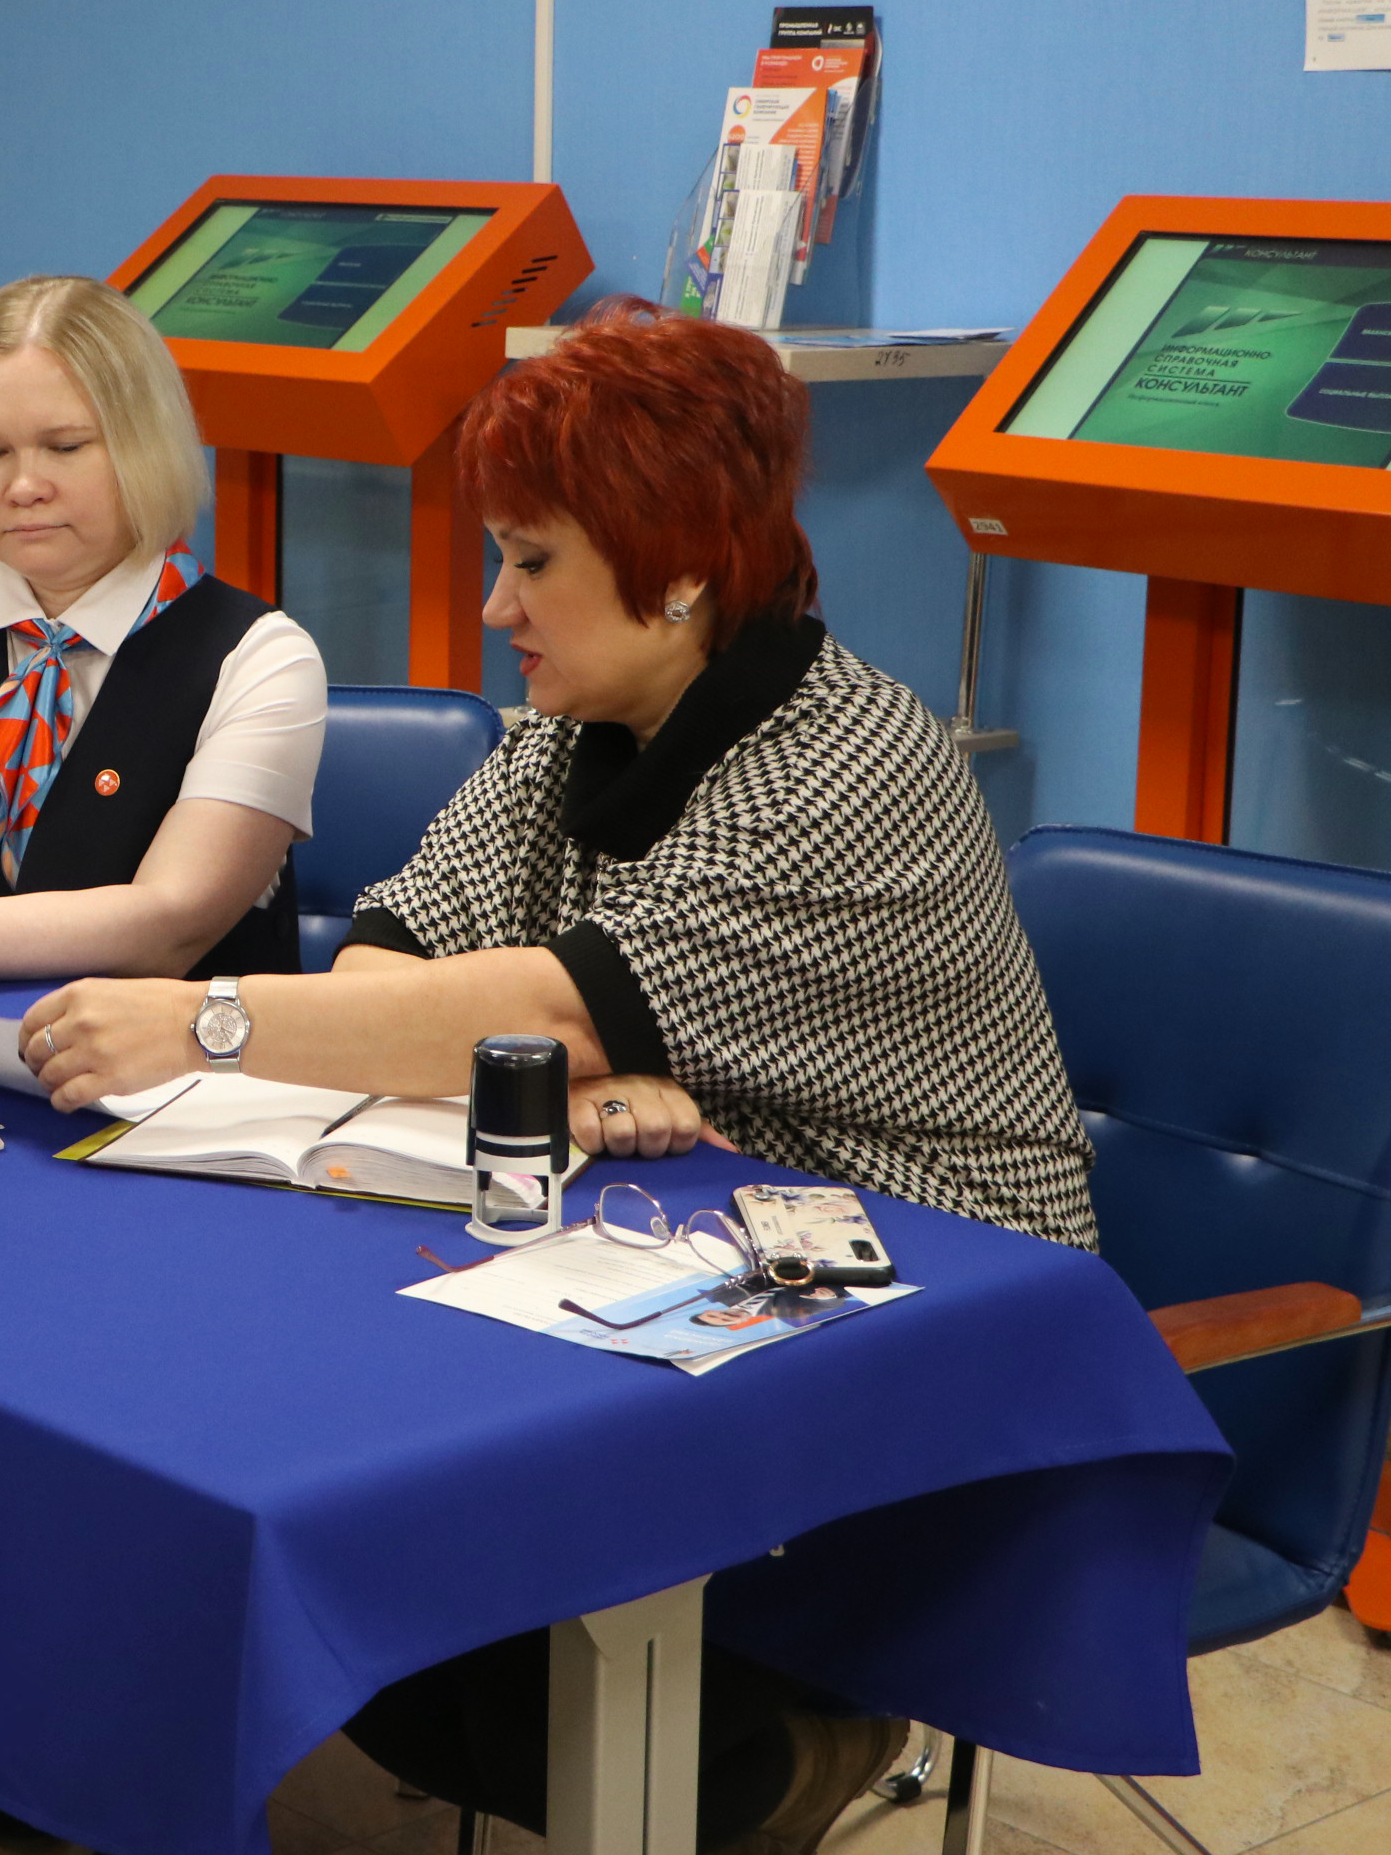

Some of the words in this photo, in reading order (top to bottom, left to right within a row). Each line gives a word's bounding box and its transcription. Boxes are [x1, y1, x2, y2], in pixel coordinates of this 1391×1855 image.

[1155, 354, 1239, 368] СПРАВОЧНАЯ
[1147, 364, 1216, 377] СИСТЕМА
[1134, 378, 1249, 398] КОНСУЛЬТАНТ
